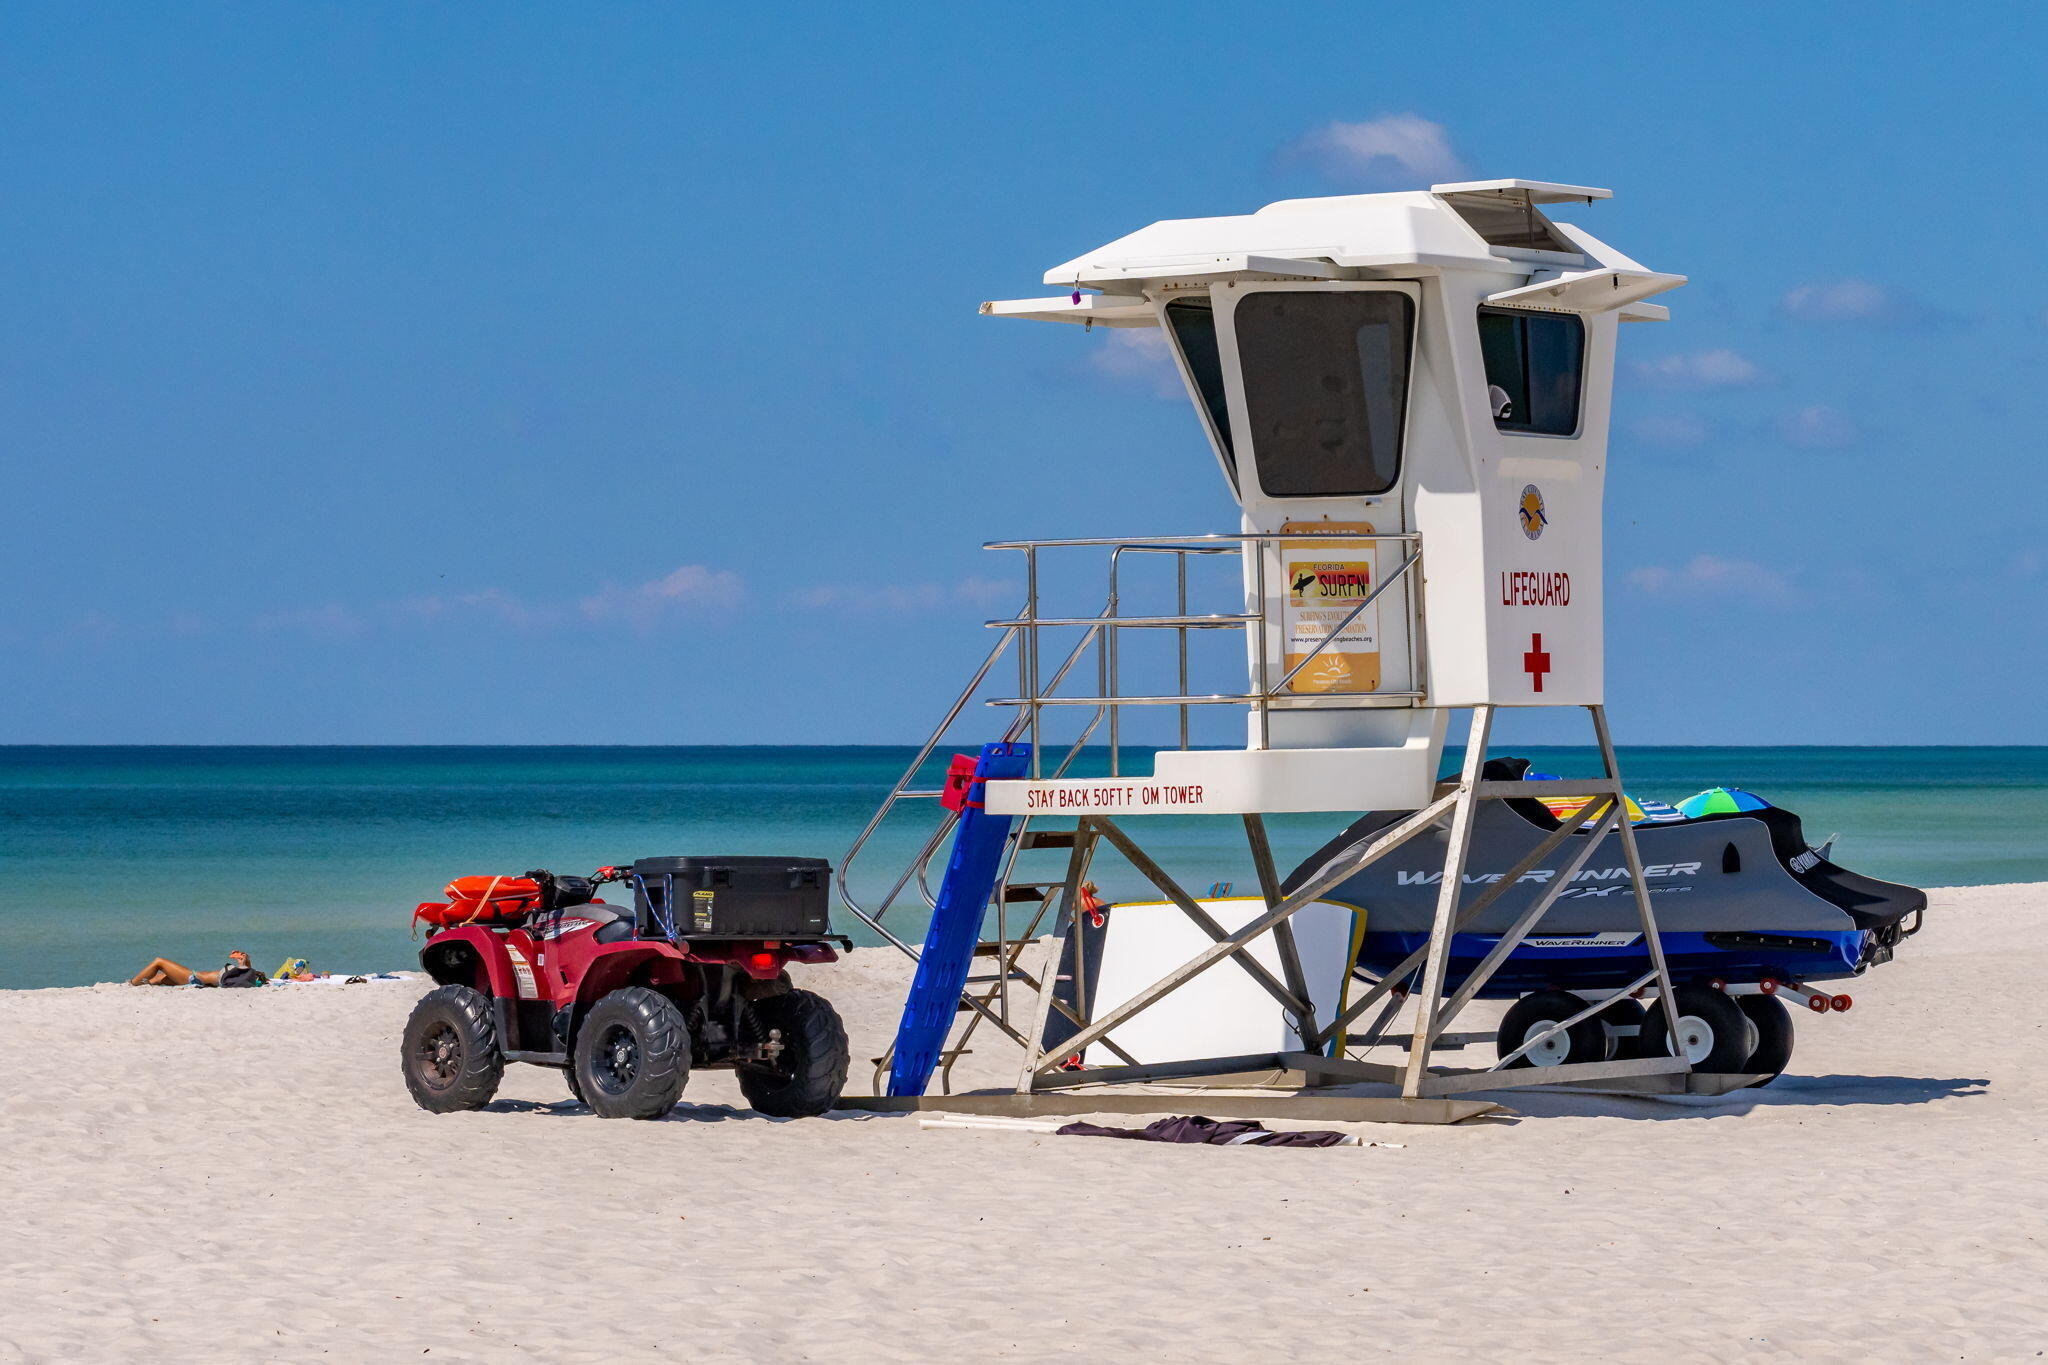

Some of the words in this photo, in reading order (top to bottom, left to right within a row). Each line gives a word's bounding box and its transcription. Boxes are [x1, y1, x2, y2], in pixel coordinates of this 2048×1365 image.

[1313, 563, 1345, 571] FLORIDA
[1320, 574, 1366, 597] SURFN
[1501, 571, 1571, 607] LIFEGUARD
[1028, 789, 1055, 808] STAY
[1059, 788, 1090, 808] BACK
[1163, 785, 1203, 805] TOWER
